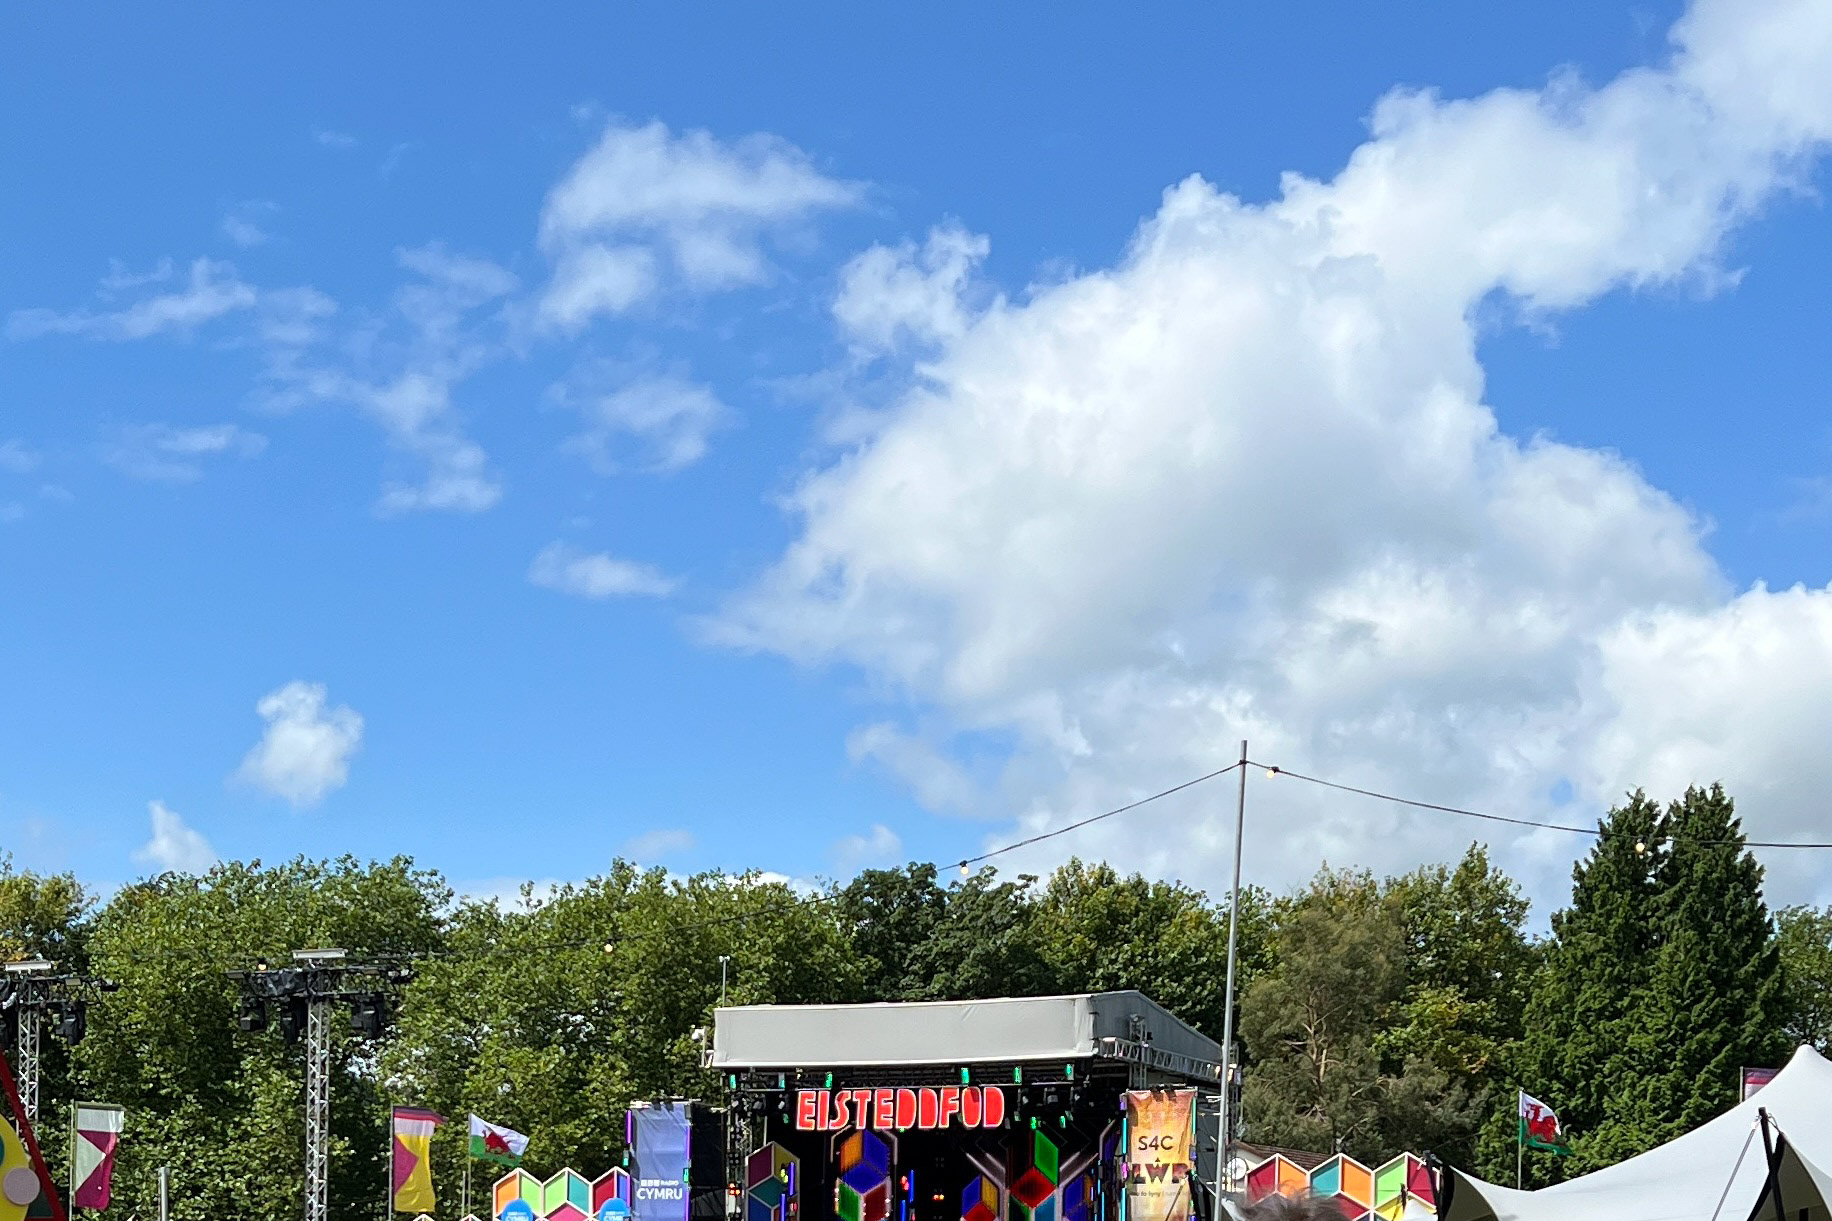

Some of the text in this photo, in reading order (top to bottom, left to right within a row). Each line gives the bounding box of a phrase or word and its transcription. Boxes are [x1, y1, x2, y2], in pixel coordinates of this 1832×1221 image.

[796, 1087, 1004, 1130] EISTEDDFOD
[1138, 1135, 1173, 1151] S4C
[636, 1187, 683, 1200] CYMRU
